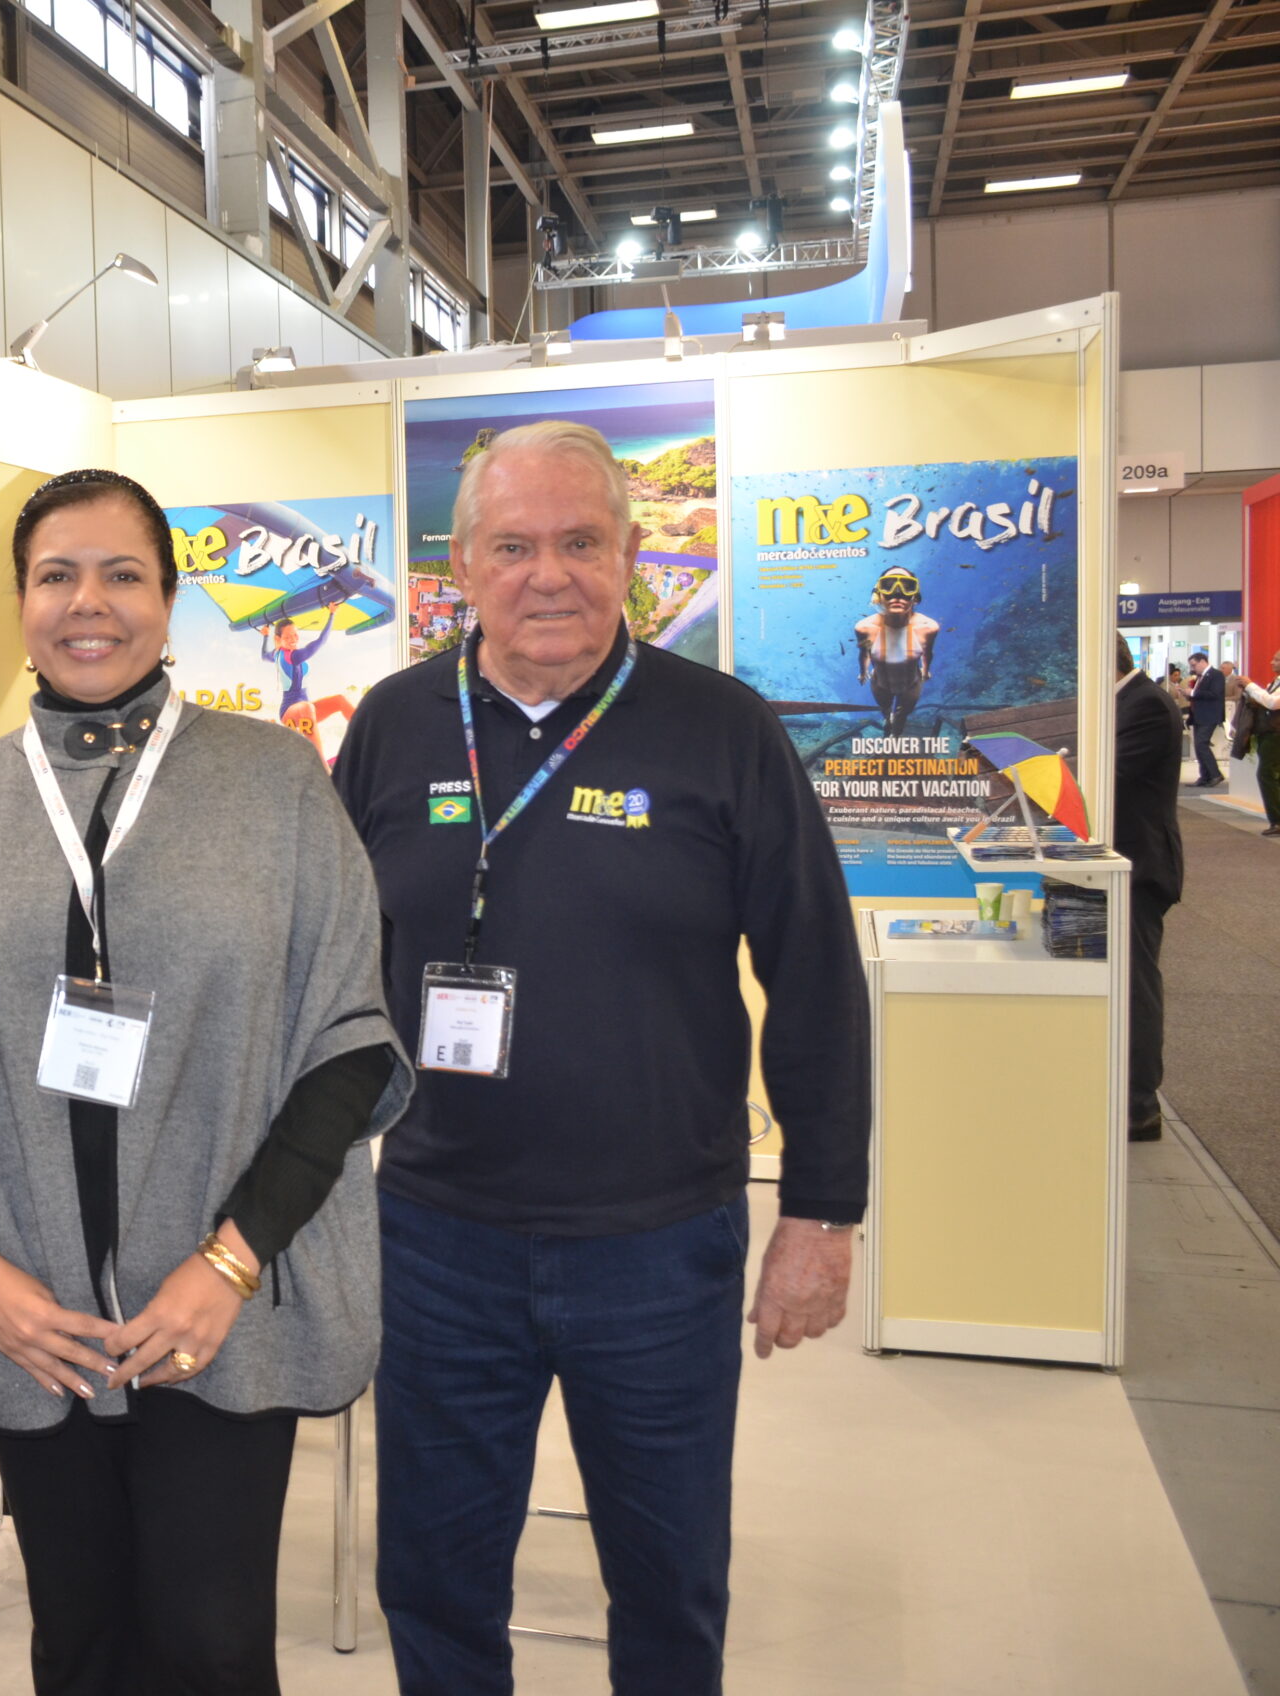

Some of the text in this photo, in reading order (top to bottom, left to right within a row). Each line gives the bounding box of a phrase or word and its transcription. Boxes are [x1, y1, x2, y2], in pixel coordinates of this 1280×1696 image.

[1122, 464, 1169, 480] 209a
[877, 478, 1055, 550] Brasil
[233, 513, 378, 577] Brasil
[422, 534, 451, 543] Fernan
[757, 547, 867, 561] mercado&eventos
[1119, 600, 1138, 614] 19
[196, 683, 262, 711] PAÍS
[564, 657, 636, 750] PERNAMBUCO
[852, 737, 950, 755] DISCOVER THE
[825, 758, 979, 776] PERFECT DESTINATION
[429, 781, 471, 795] PRESS
[843, 781, 879, 797] YOUR
[882, 780, 919, 797] NEXT
[921, 780, 990, 797] VACATION
[884, 815, 911, 824] unique
[965, 816, 979, 824] you
[437, 1045, 446, 1061] E
